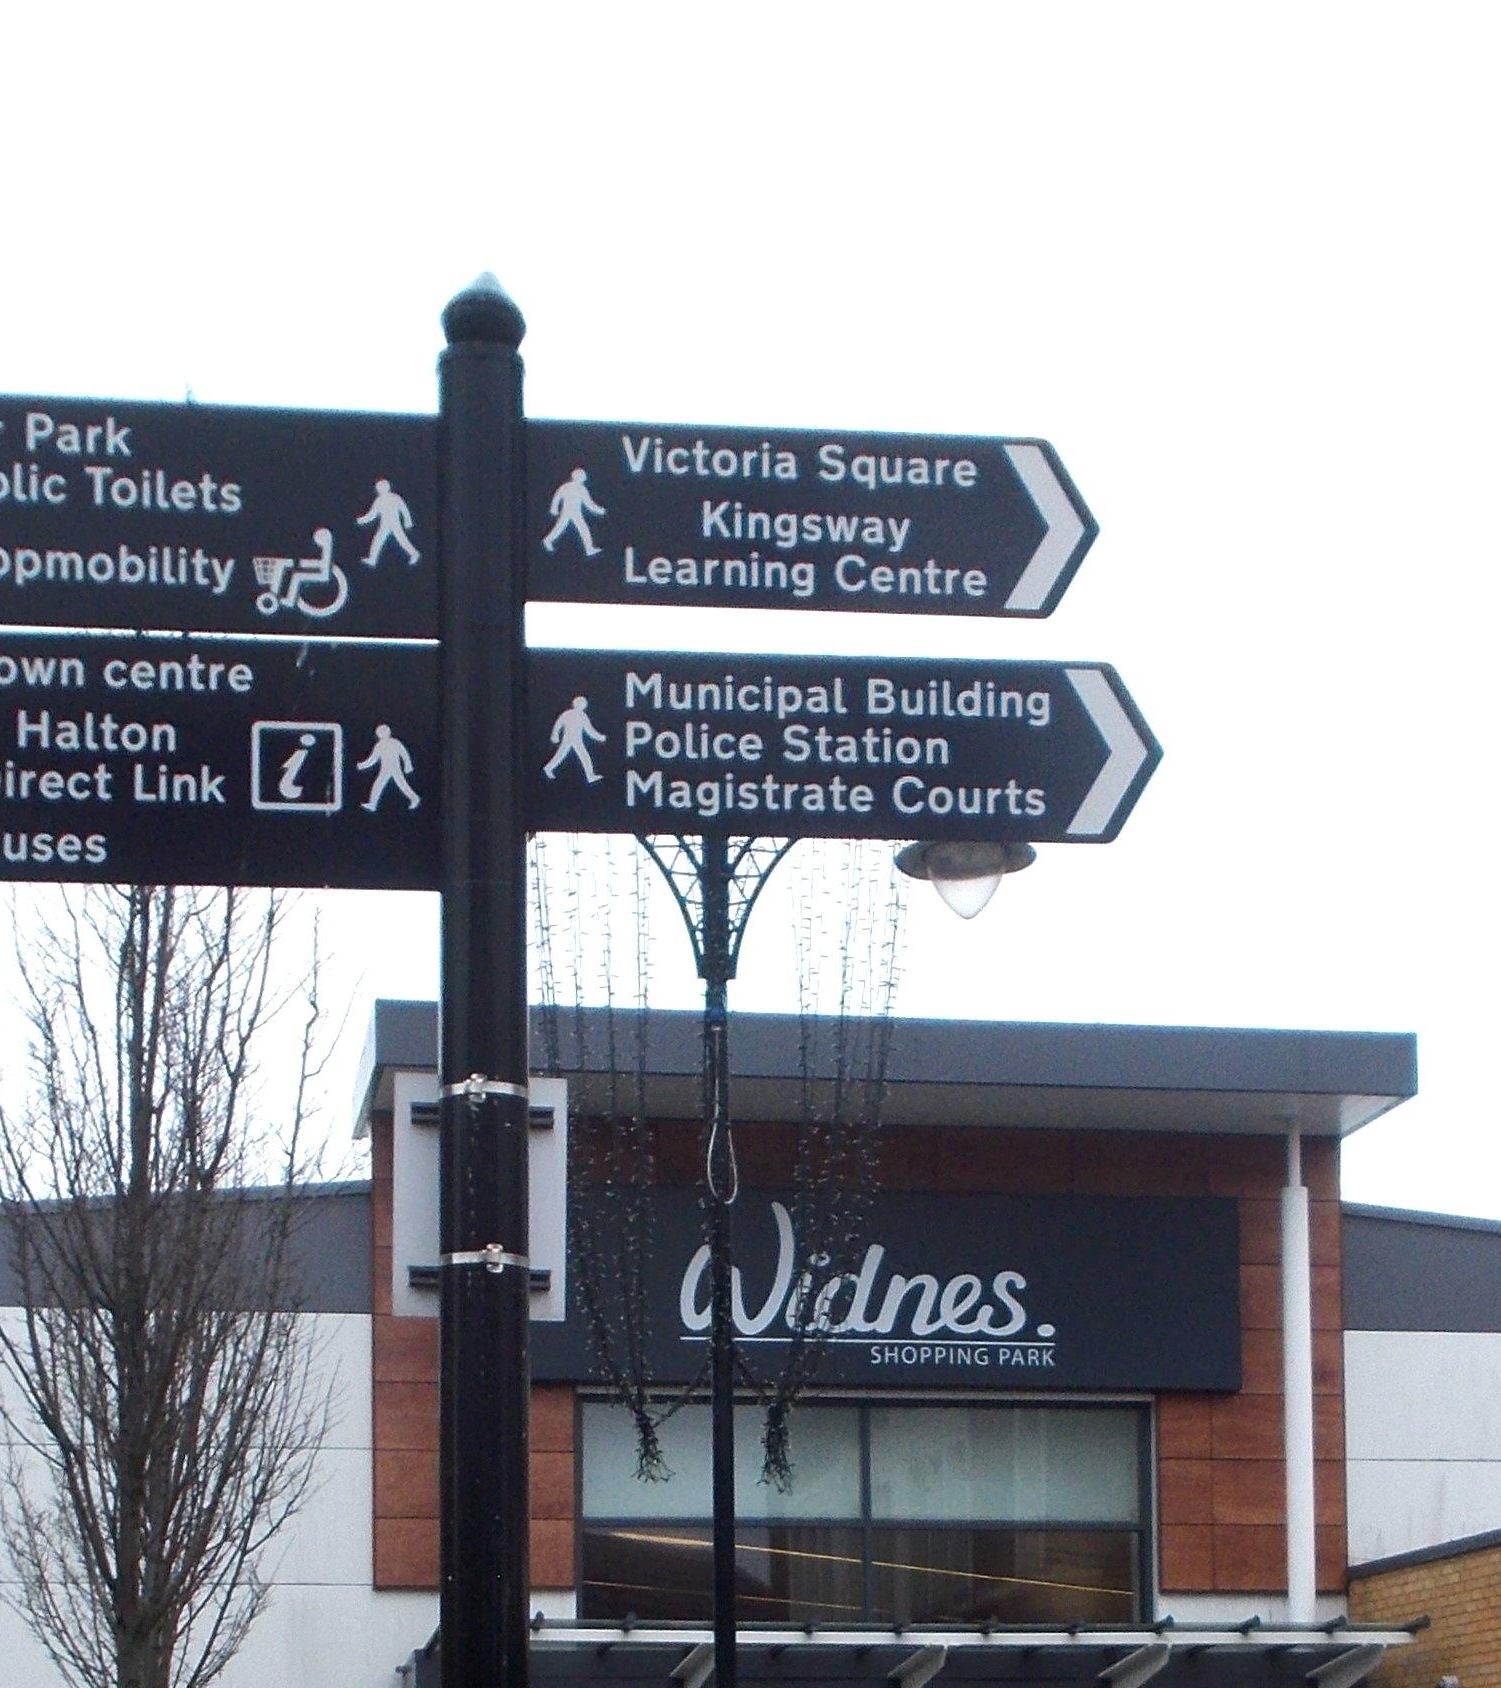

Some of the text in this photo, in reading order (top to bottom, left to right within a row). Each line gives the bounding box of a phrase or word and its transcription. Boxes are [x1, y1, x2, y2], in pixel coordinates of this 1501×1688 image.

[26, 412, 131, 456] Park
[621, 435, 978, 489] Victoria Square
[84, 466, 242, 513] Toilets
[702, 500, 911, 553] Kingsway
[625, 547, 988, 598] Learning Centre
[103, 654, 253, 692] centre
[625, 671, 1051, 727] Municipal Building
[18, 710, 176, 752] Halton
[626, 720, 949, 765] Police Station
[134, 763, 225, 803] Link
[626, 770, 1046, 817] Magistrate Courts
[870, 1346, 1055, 1367] SHOPPING PARK
